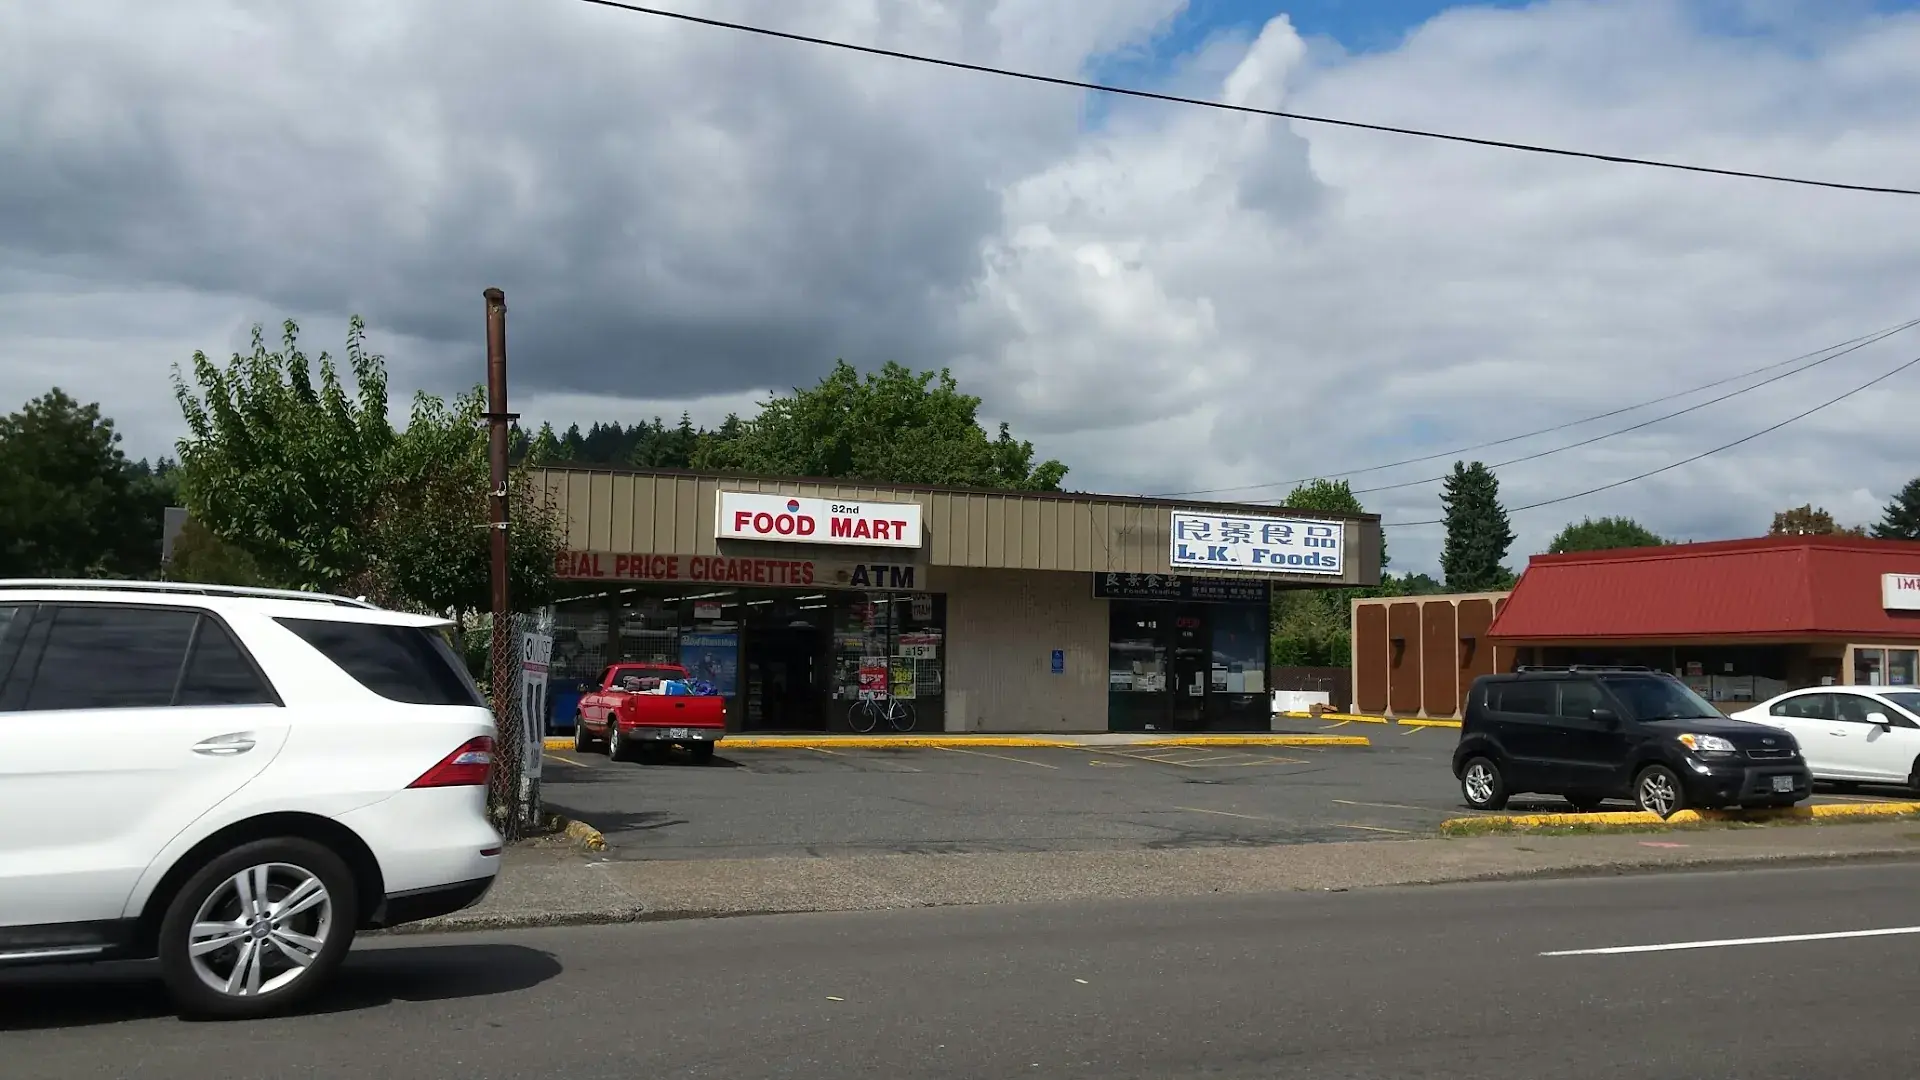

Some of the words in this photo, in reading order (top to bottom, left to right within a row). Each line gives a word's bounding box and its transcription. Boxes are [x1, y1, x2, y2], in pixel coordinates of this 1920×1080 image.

[831, 504, 859, 515] 82nd
[734, 511, 815, 536] FOOD
[831, 517, 906, 540] MART
[1177, 519, 1336, 549] 良景食品
[1177, 544, 1237, 562] L.K.
[1252, 548, 1337, 567] Foods
[615, 554, 678, 580] PRICE
[689, 559, 814, 585] CIGARETTES
[850, 564, 914, 589] ATM
